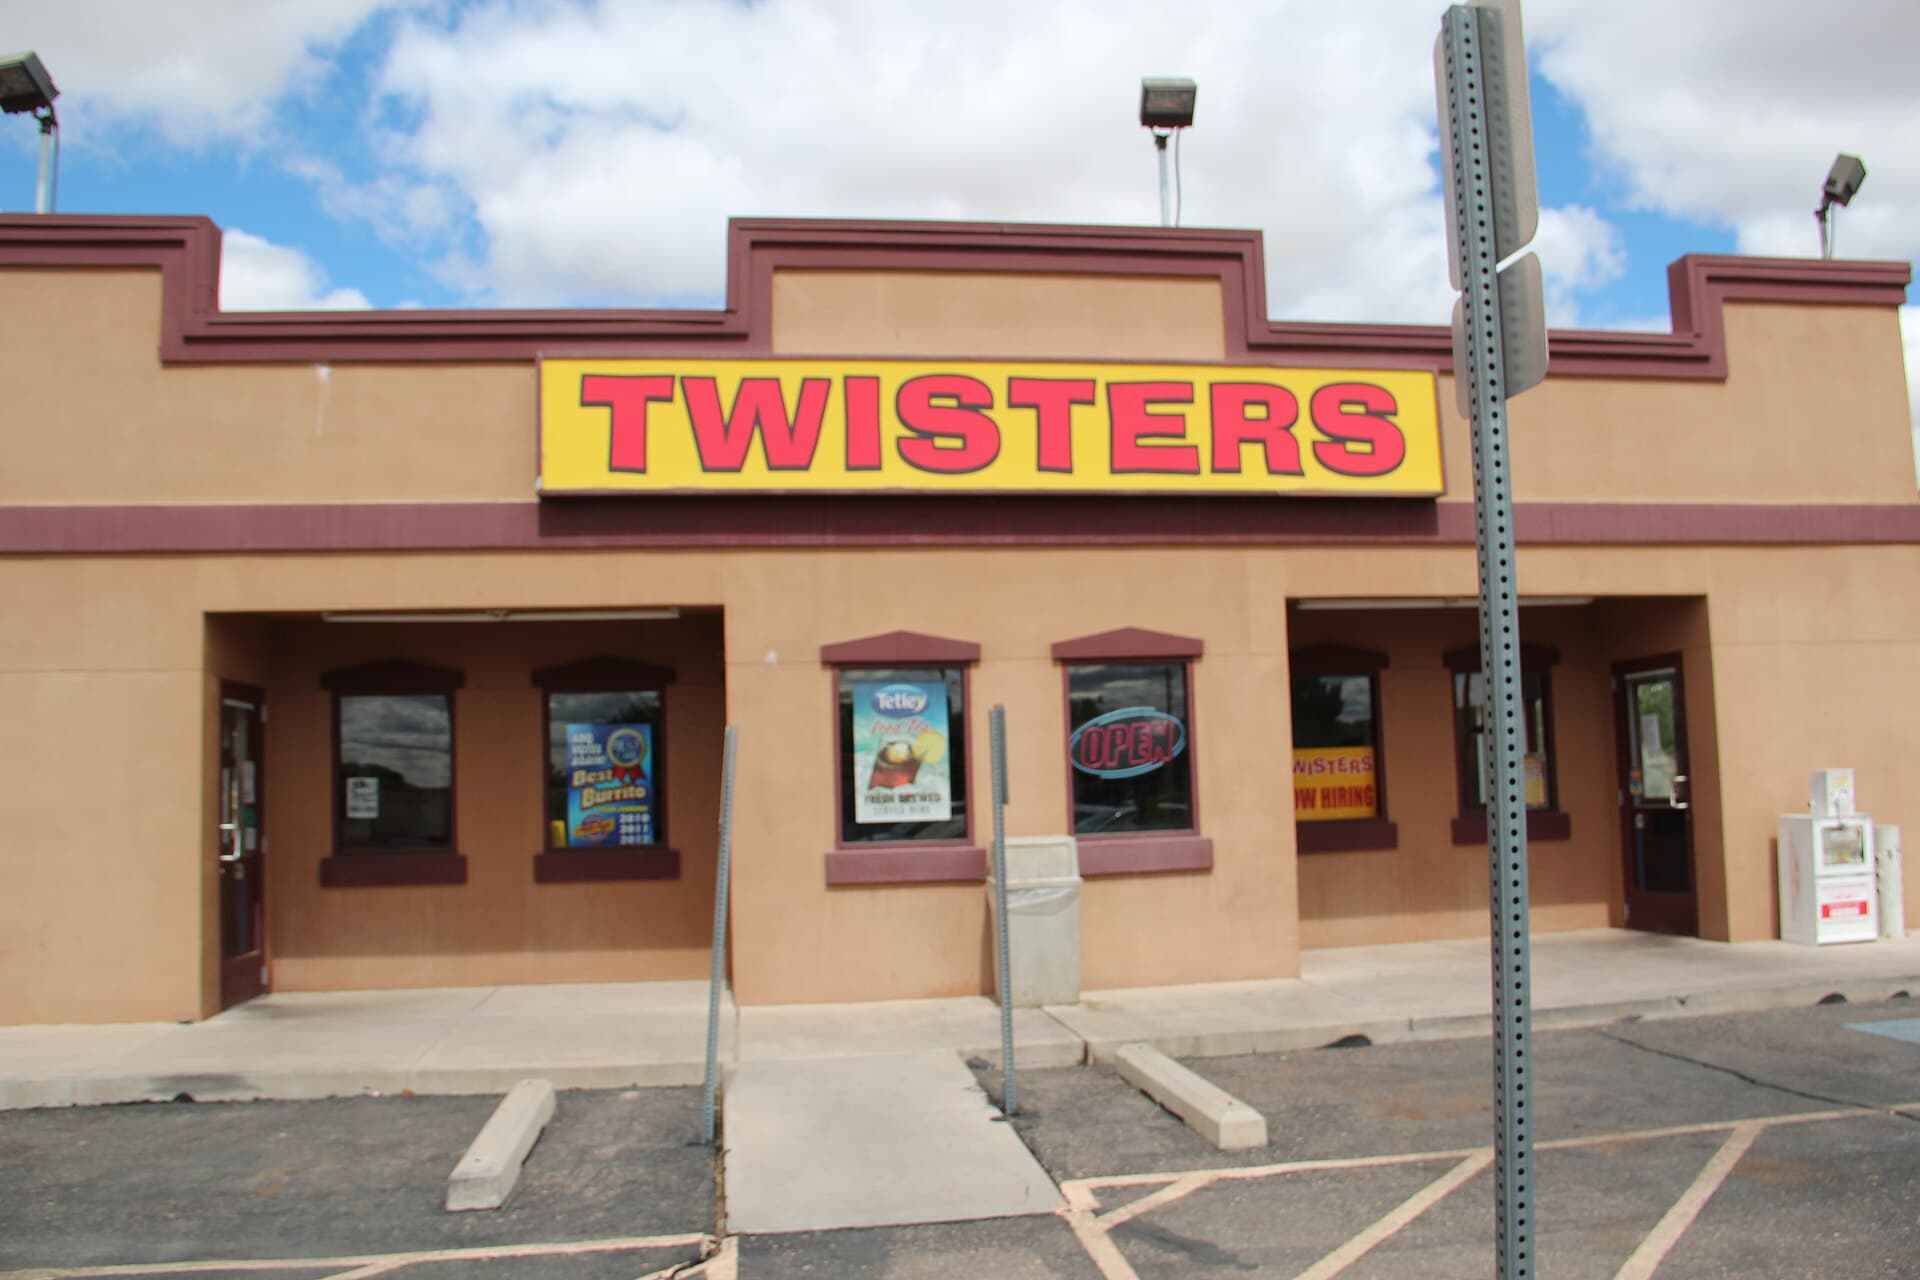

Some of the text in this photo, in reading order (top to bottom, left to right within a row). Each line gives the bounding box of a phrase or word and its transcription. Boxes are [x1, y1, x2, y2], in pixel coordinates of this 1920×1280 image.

[580, 373, 1406, 478] TWISTERS
[876, 692, 927, 713] Tetley
[1080, 719, 1175, 769] OPEN
[572, 769, 613, 787] Best
[1294, 755, 1373, 776] WISTERS
[581, 784, 647, 810] Burrito
[1320, 784, 1374, 809] HIRING
